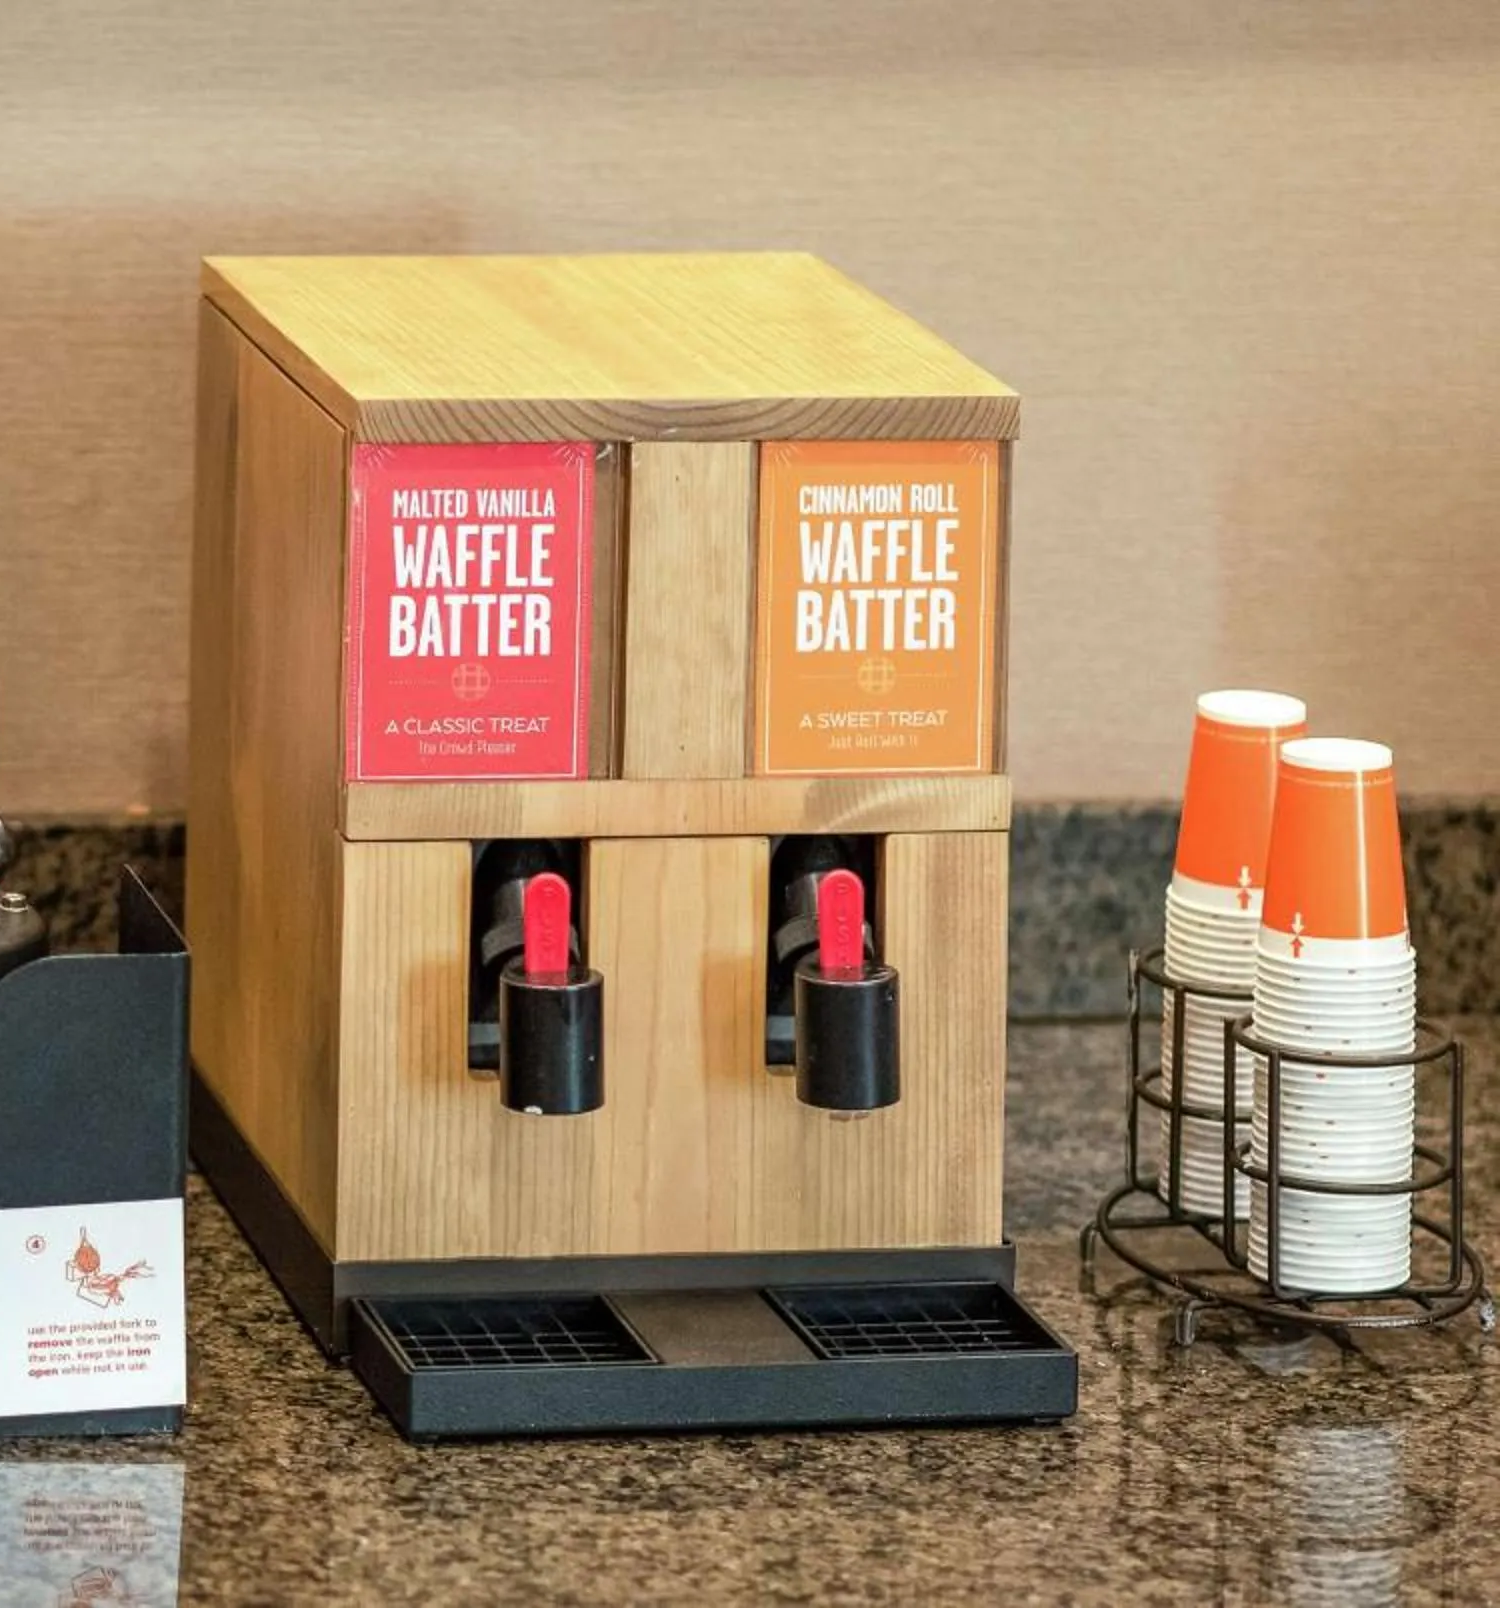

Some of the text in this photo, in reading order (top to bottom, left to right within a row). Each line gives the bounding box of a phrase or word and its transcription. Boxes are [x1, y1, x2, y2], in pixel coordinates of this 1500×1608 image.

[392, 488, 555, 519] MALTED VANILLA
[798, 483, 959, 515] CINNAMON ROLL
[392, 523, 555, 588] WAFFLE
[799, 518, 959, 584] WAFFLE
[389, 593, 552, 657] BATTER
[796, 587, 956, 652] BATTER
[384, 716, 550, 735] A CLASSIC TREAT
[799, 710, 948, 729] A SWEET TREAT
[27, 1339, 73, 1349] remove
